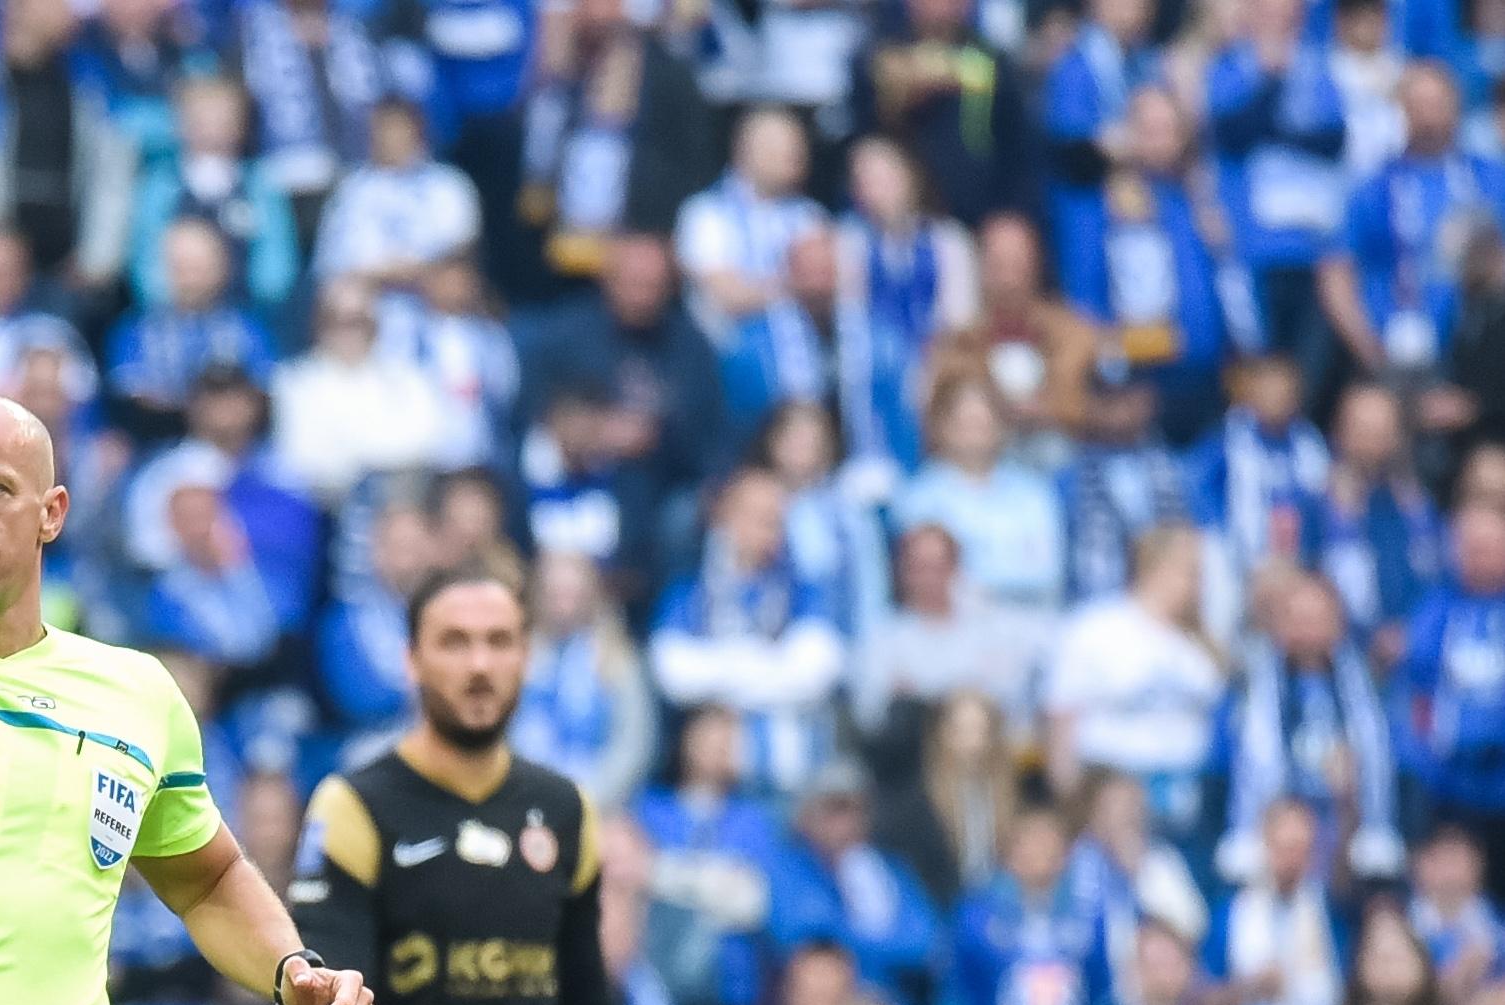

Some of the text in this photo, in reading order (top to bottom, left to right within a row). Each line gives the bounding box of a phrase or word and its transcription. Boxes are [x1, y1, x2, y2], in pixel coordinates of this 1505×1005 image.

[97, 772, 136, 814] FIFA
[94, 807, 133, 841] REFEREE
[95, 843, 115, 863] 2022
